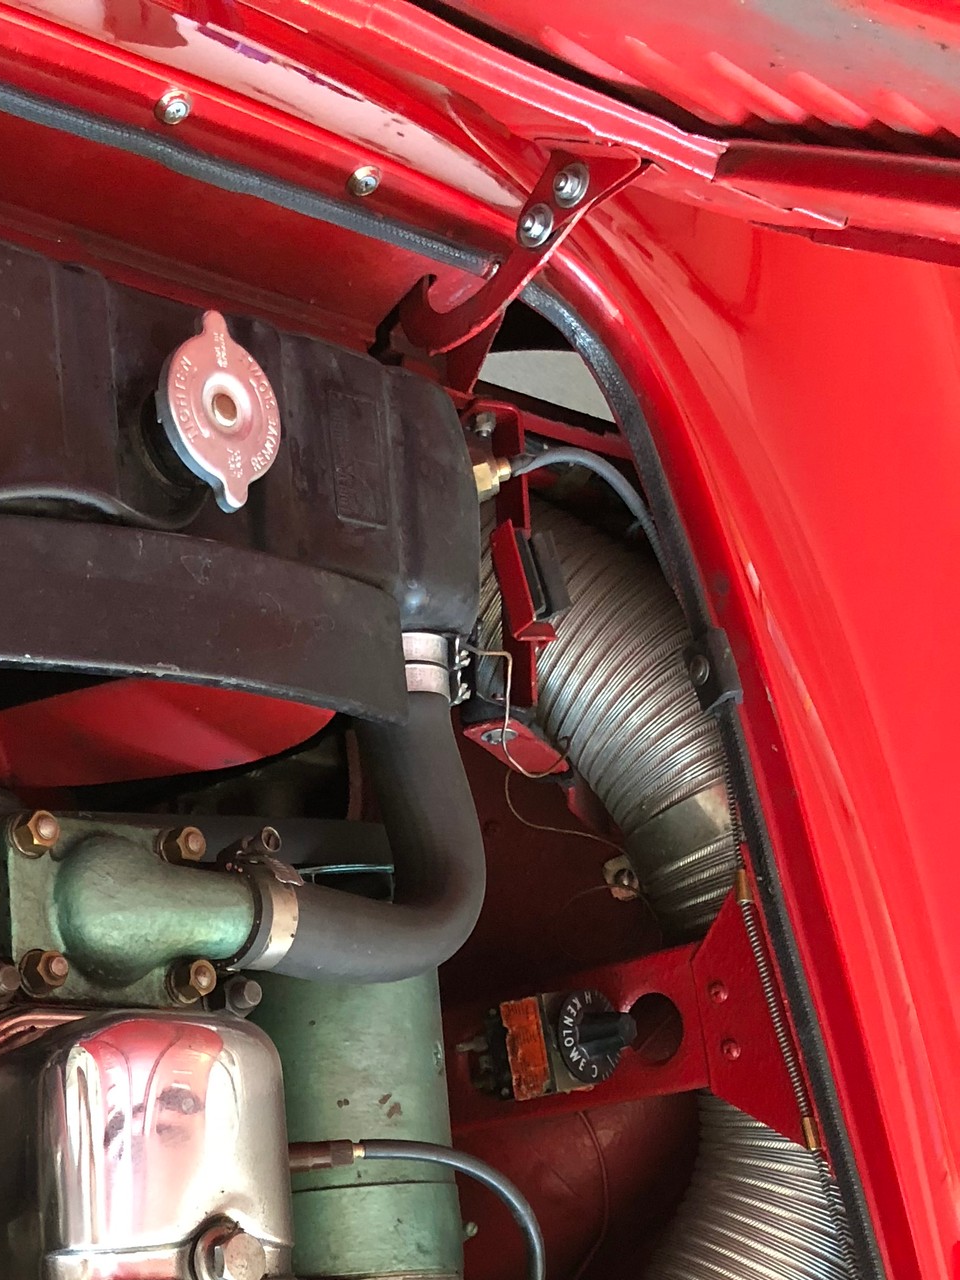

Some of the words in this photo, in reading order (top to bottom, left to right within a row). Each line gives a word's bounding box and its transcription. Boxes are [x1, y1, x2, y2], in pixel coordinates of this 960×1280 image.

[174, 355, 200, 443] TIGHTEN
[250, 415, 279, 473] REMOVE
[562, 996, 587, 1072] KENLOWE
